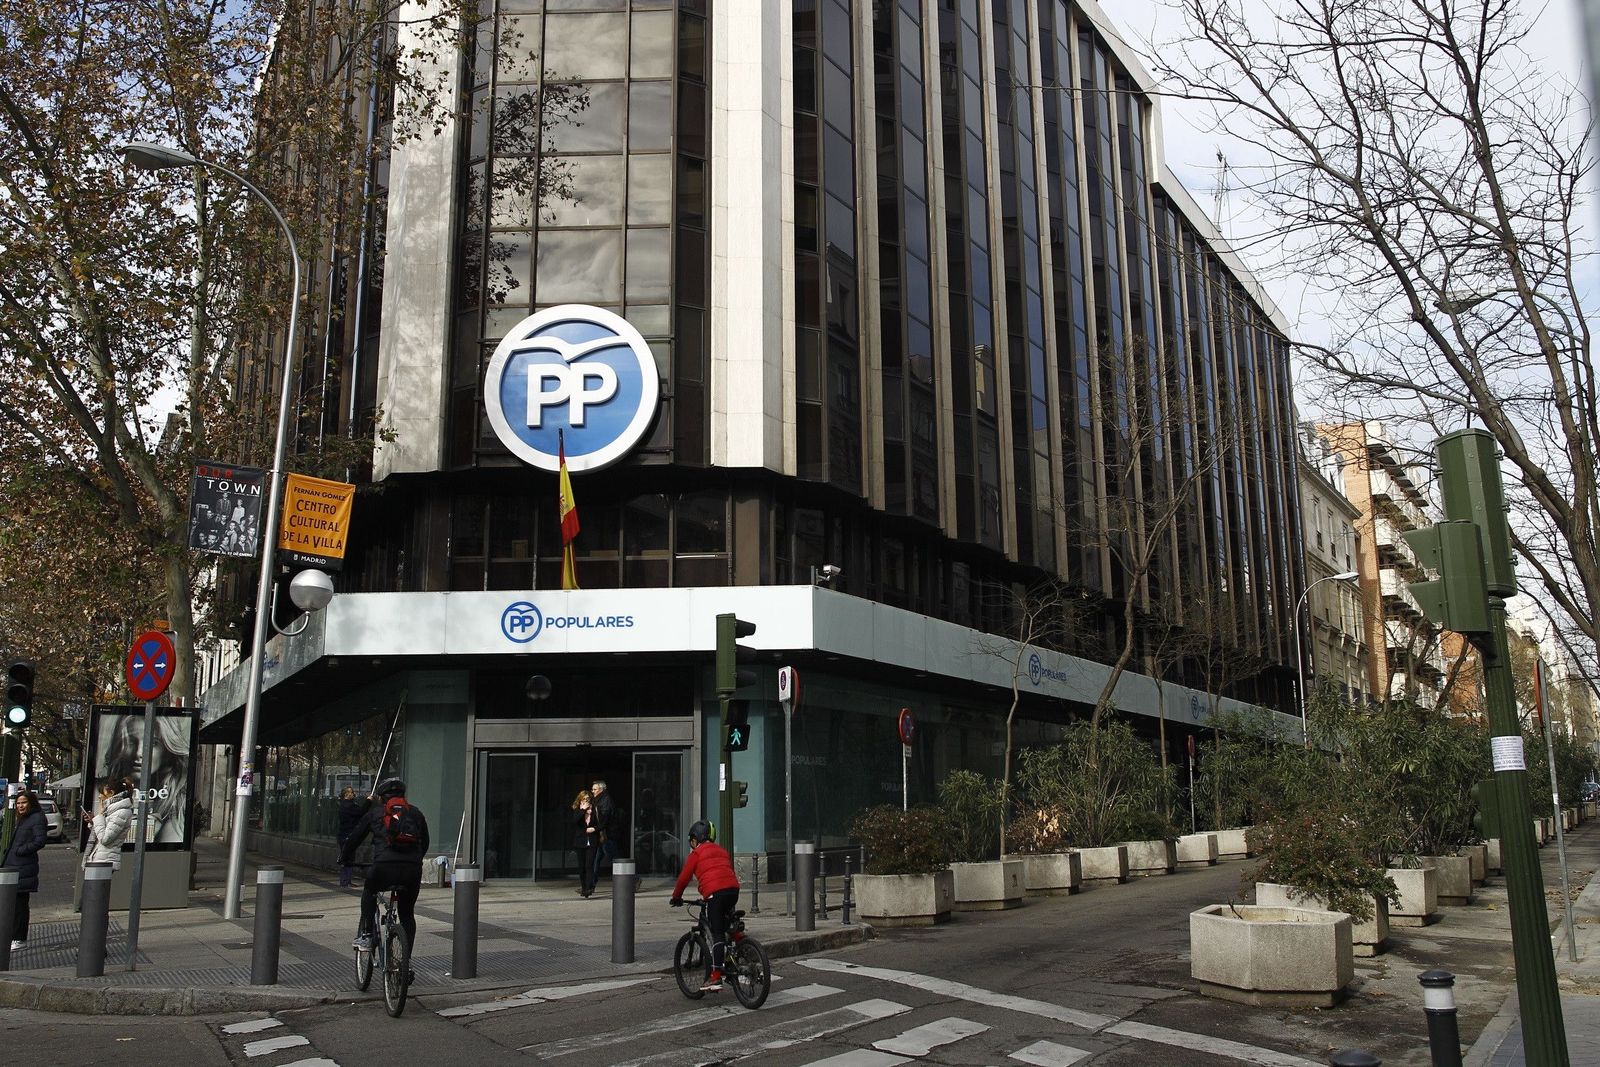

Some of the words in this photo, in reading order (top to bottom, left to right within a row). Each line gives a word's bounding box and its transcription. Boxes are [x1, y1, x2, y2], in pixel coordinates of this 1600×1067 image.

[526, 362, 618, 426] PP
[207, 479, 261, 495] TOWN
[296, 499, 337, 515] CENTRO
[289, 514, 340, 533] CULTURAL
[283, 530, 295, 542] DE
[297, 533, 309, 544] LA
[312, 536, 342, 550] VILLA
[300, 555, 327, 565] MADRID
[509, 615, 535, 633] PP
[545, 615, 634, 629] POPULARES
